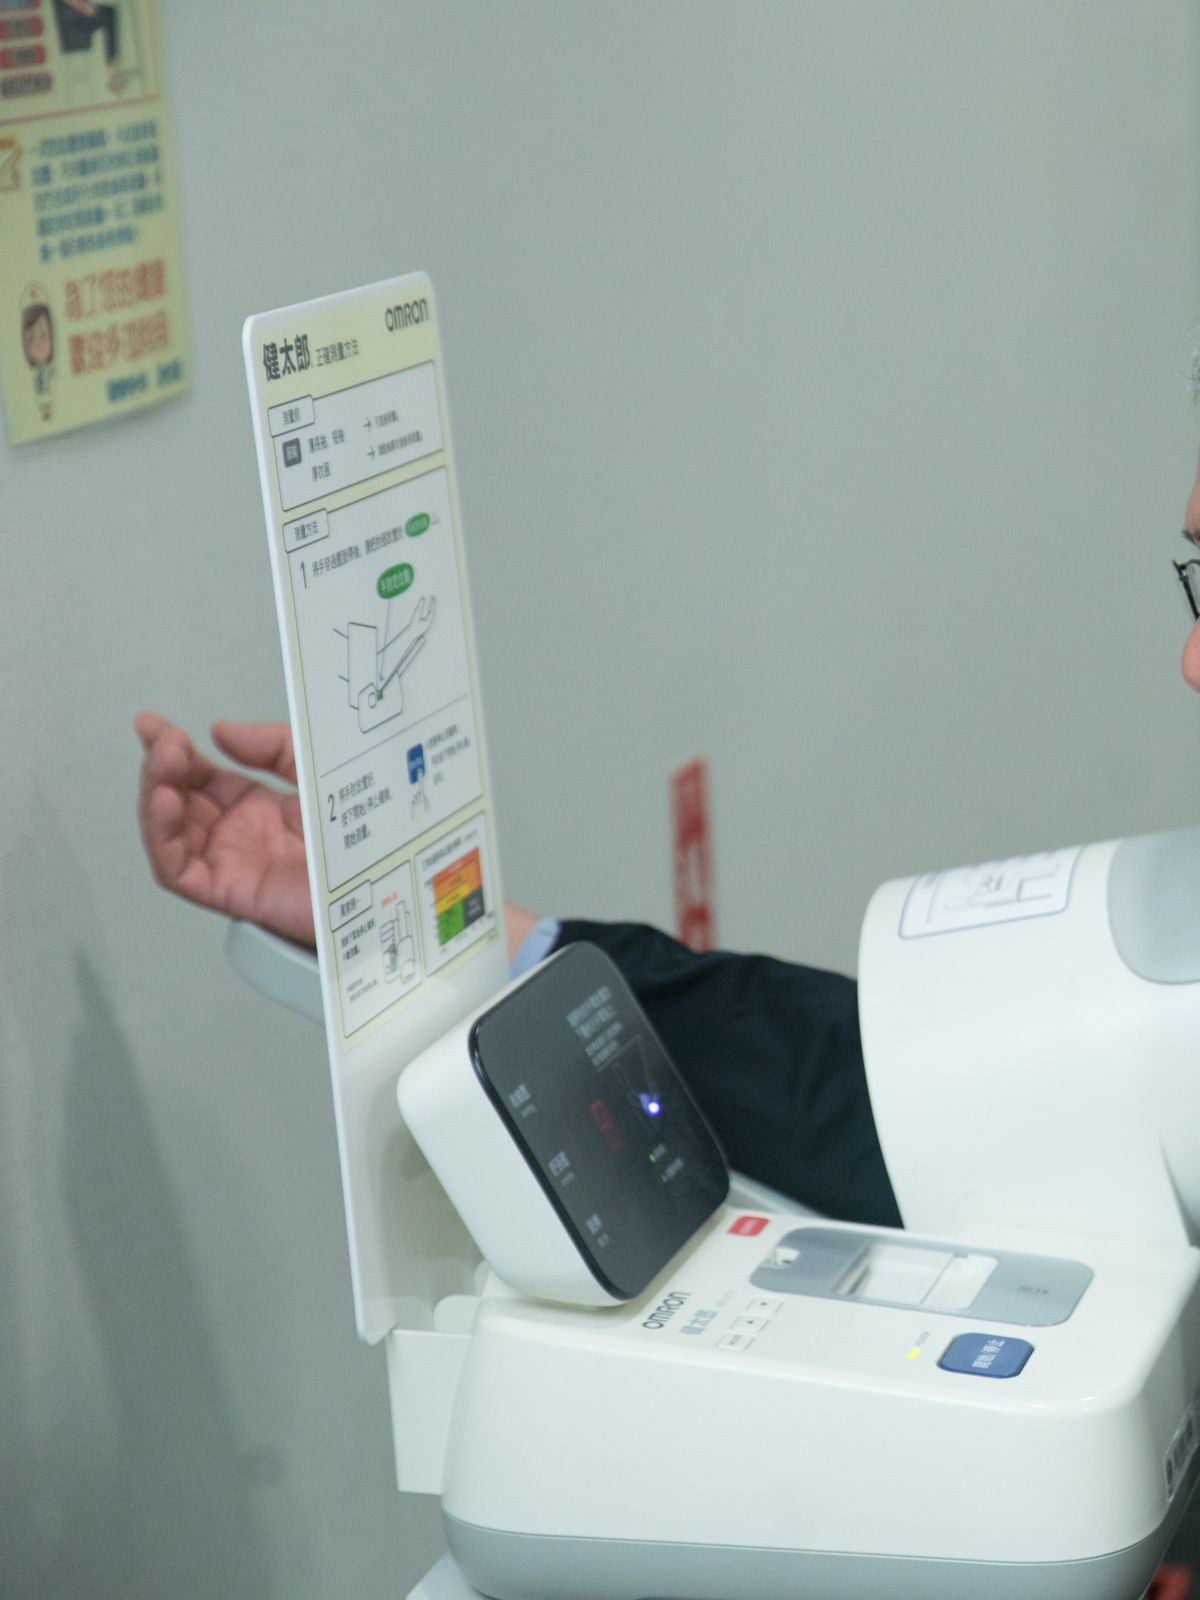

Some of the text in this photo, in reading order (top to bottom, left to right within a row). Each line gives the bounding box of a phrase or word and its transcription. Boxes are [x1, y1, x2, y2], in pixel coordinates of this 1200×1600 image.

[384, 298, 429, 332] OMRON
[262, 333, 312, 382] 健太郎
[327, 793, 337, 823] 2
[641, 1291, 692, 1330] OMRON
